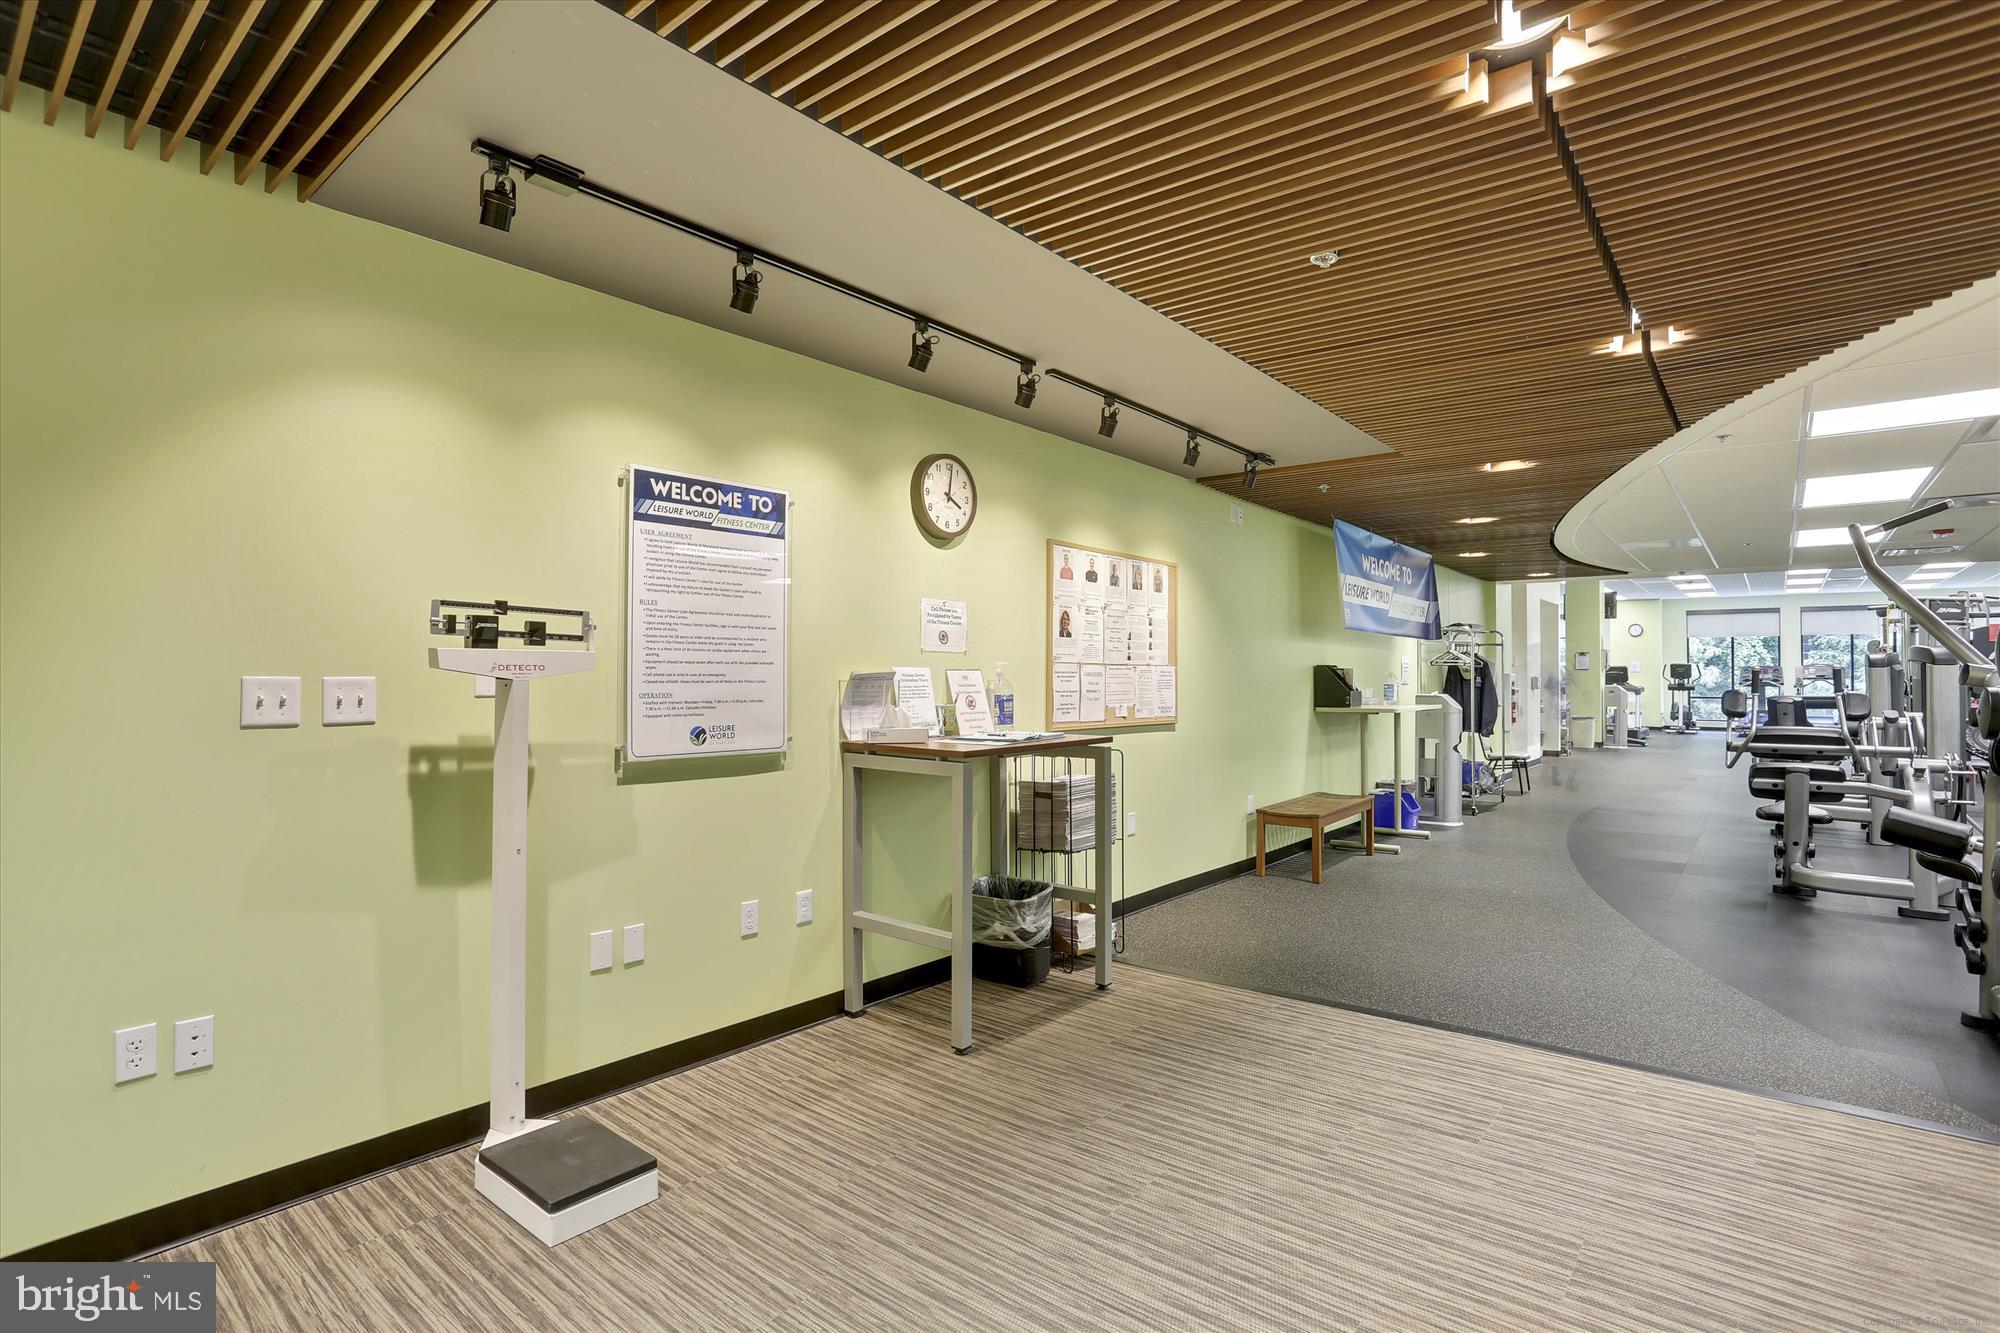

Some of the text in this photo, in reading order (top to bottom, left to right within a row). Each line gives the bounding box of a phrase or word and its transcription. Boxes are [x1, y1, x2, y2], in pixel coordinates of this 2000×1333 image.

[962, 481, 967, 490] 2
[649, 477, 773, 514] WELCOME TO
[964, 497, 969, 505] 3
[928, 503, 933, 511] 8
[653, 504, 714, 520] LEISURE WORLD
[717, 517, 771, 532] FITNESS CENTER
[945, 521, 950, 529] 6
[955, 519, 960, 527] 5
[640, 528, 692, 540] USER AGREEMENT
[1361, 553, 1412, 585] WELCOME TO
[1344, 582, 1390, 604] LEISURE WORLD
[640, 598, 658, 606] RULES
[497, 664, 546, 672] DETECTO
[709, 724, 736, 732] LEISURE
[709, 732, 736, 740] WORLD
